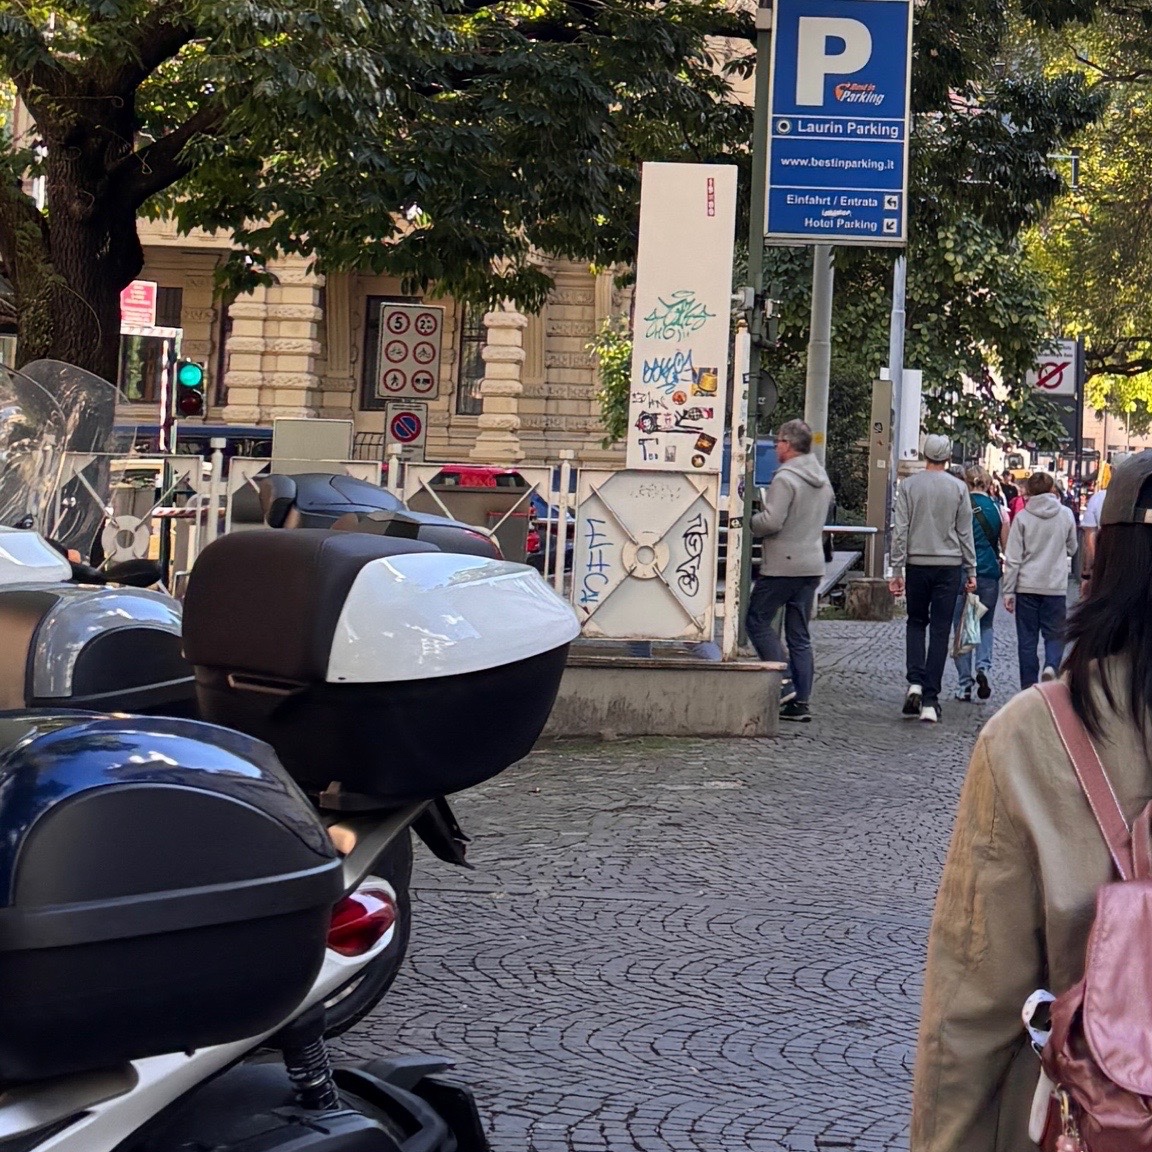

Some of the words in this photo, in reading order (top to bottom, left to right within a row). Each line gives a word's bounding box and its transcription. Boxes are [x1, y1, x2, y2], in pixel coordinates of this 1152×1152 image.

[796, 16, 872, 106] P
[840, 90, 885, 106] Parking
[798, 120, 843, 134] Laurin
[847, 122, 899, 138] Parking
[780, 157, 894, 171] www.bestinparking.it
[786, 194, 831, 206] Einfahrt
[840, 196, 878, 207] Entrata
[804, 217, 833, 228] Hotel
[836, 218, 878, 232] Parking
[394, 316, 403, 330] 5
